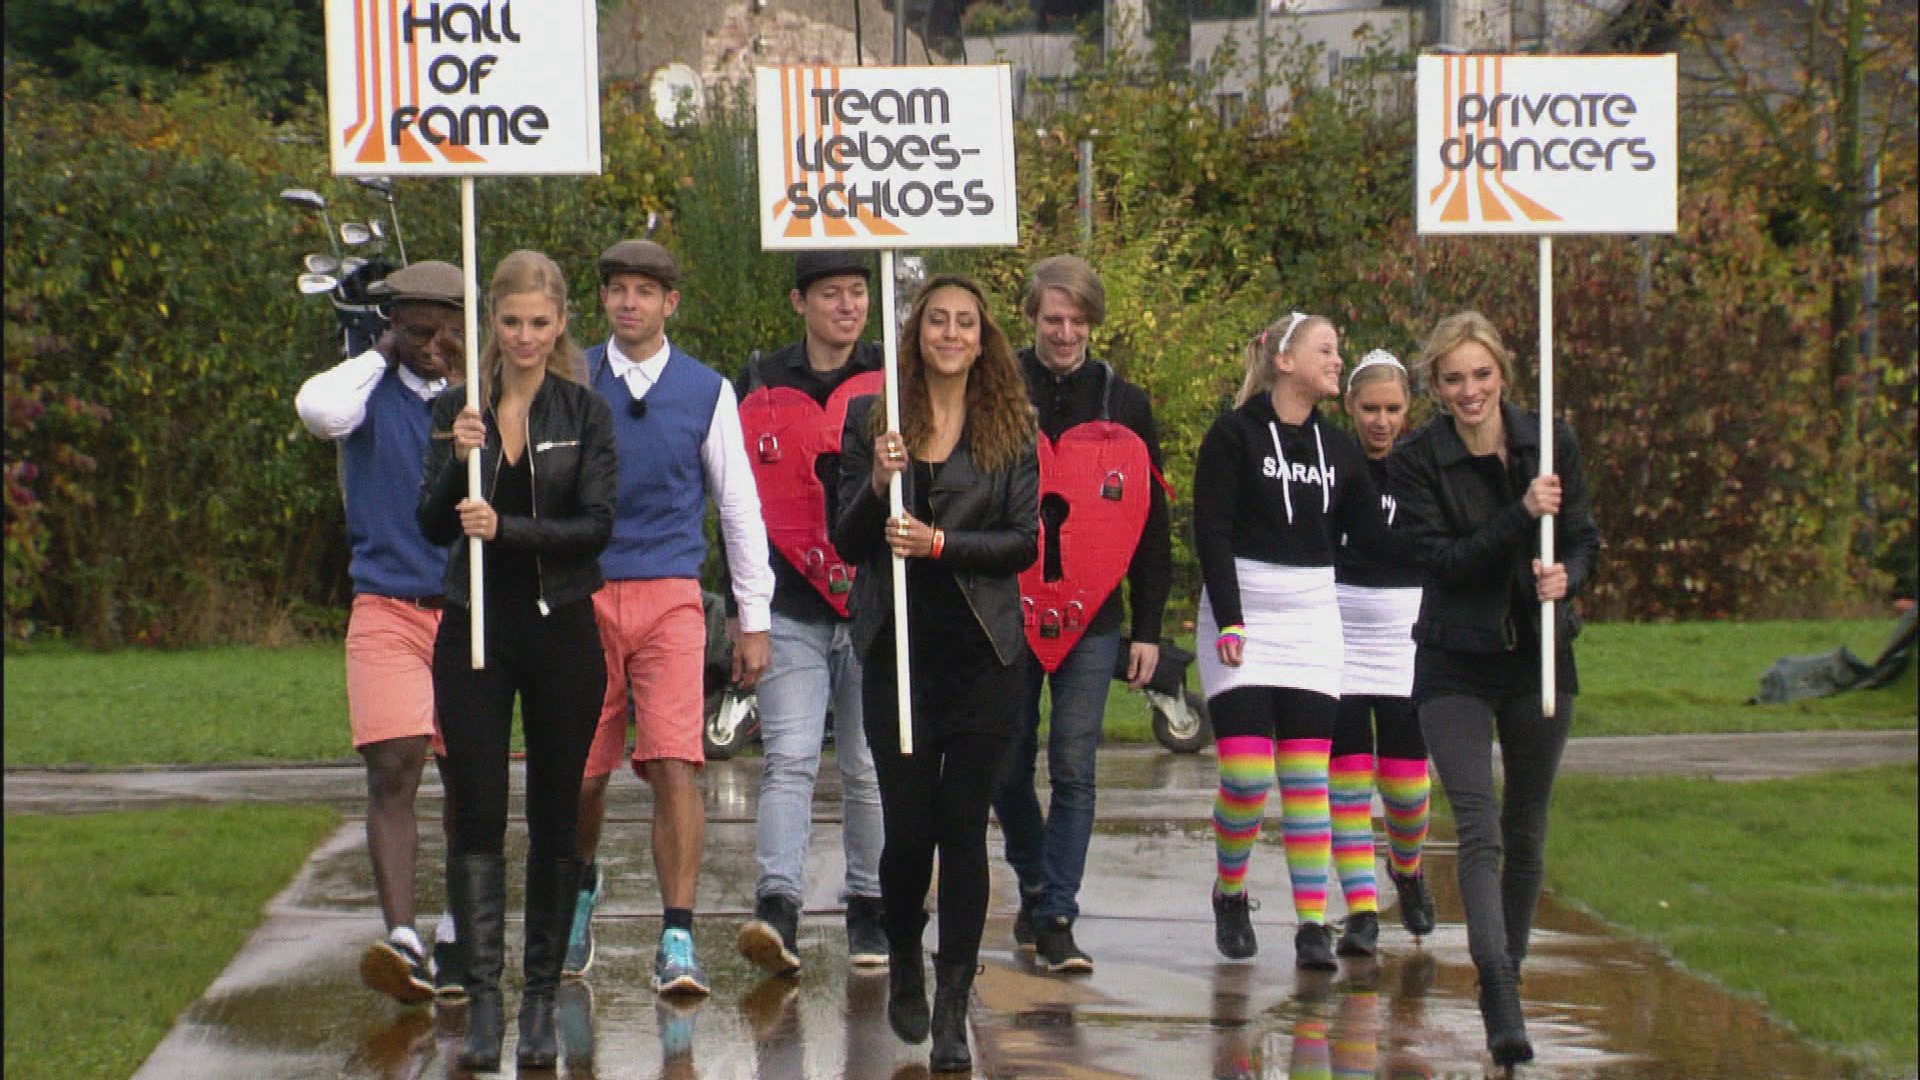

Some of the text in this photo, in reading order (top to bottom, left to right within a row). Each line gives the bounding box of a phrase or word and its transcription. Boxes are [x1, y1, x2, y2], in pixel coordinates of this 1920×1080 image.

[811, 88, 949, 126] Team
[1439, 133, 1655, 172] dancers
[1262, 456, 1335, 487] SARAH
